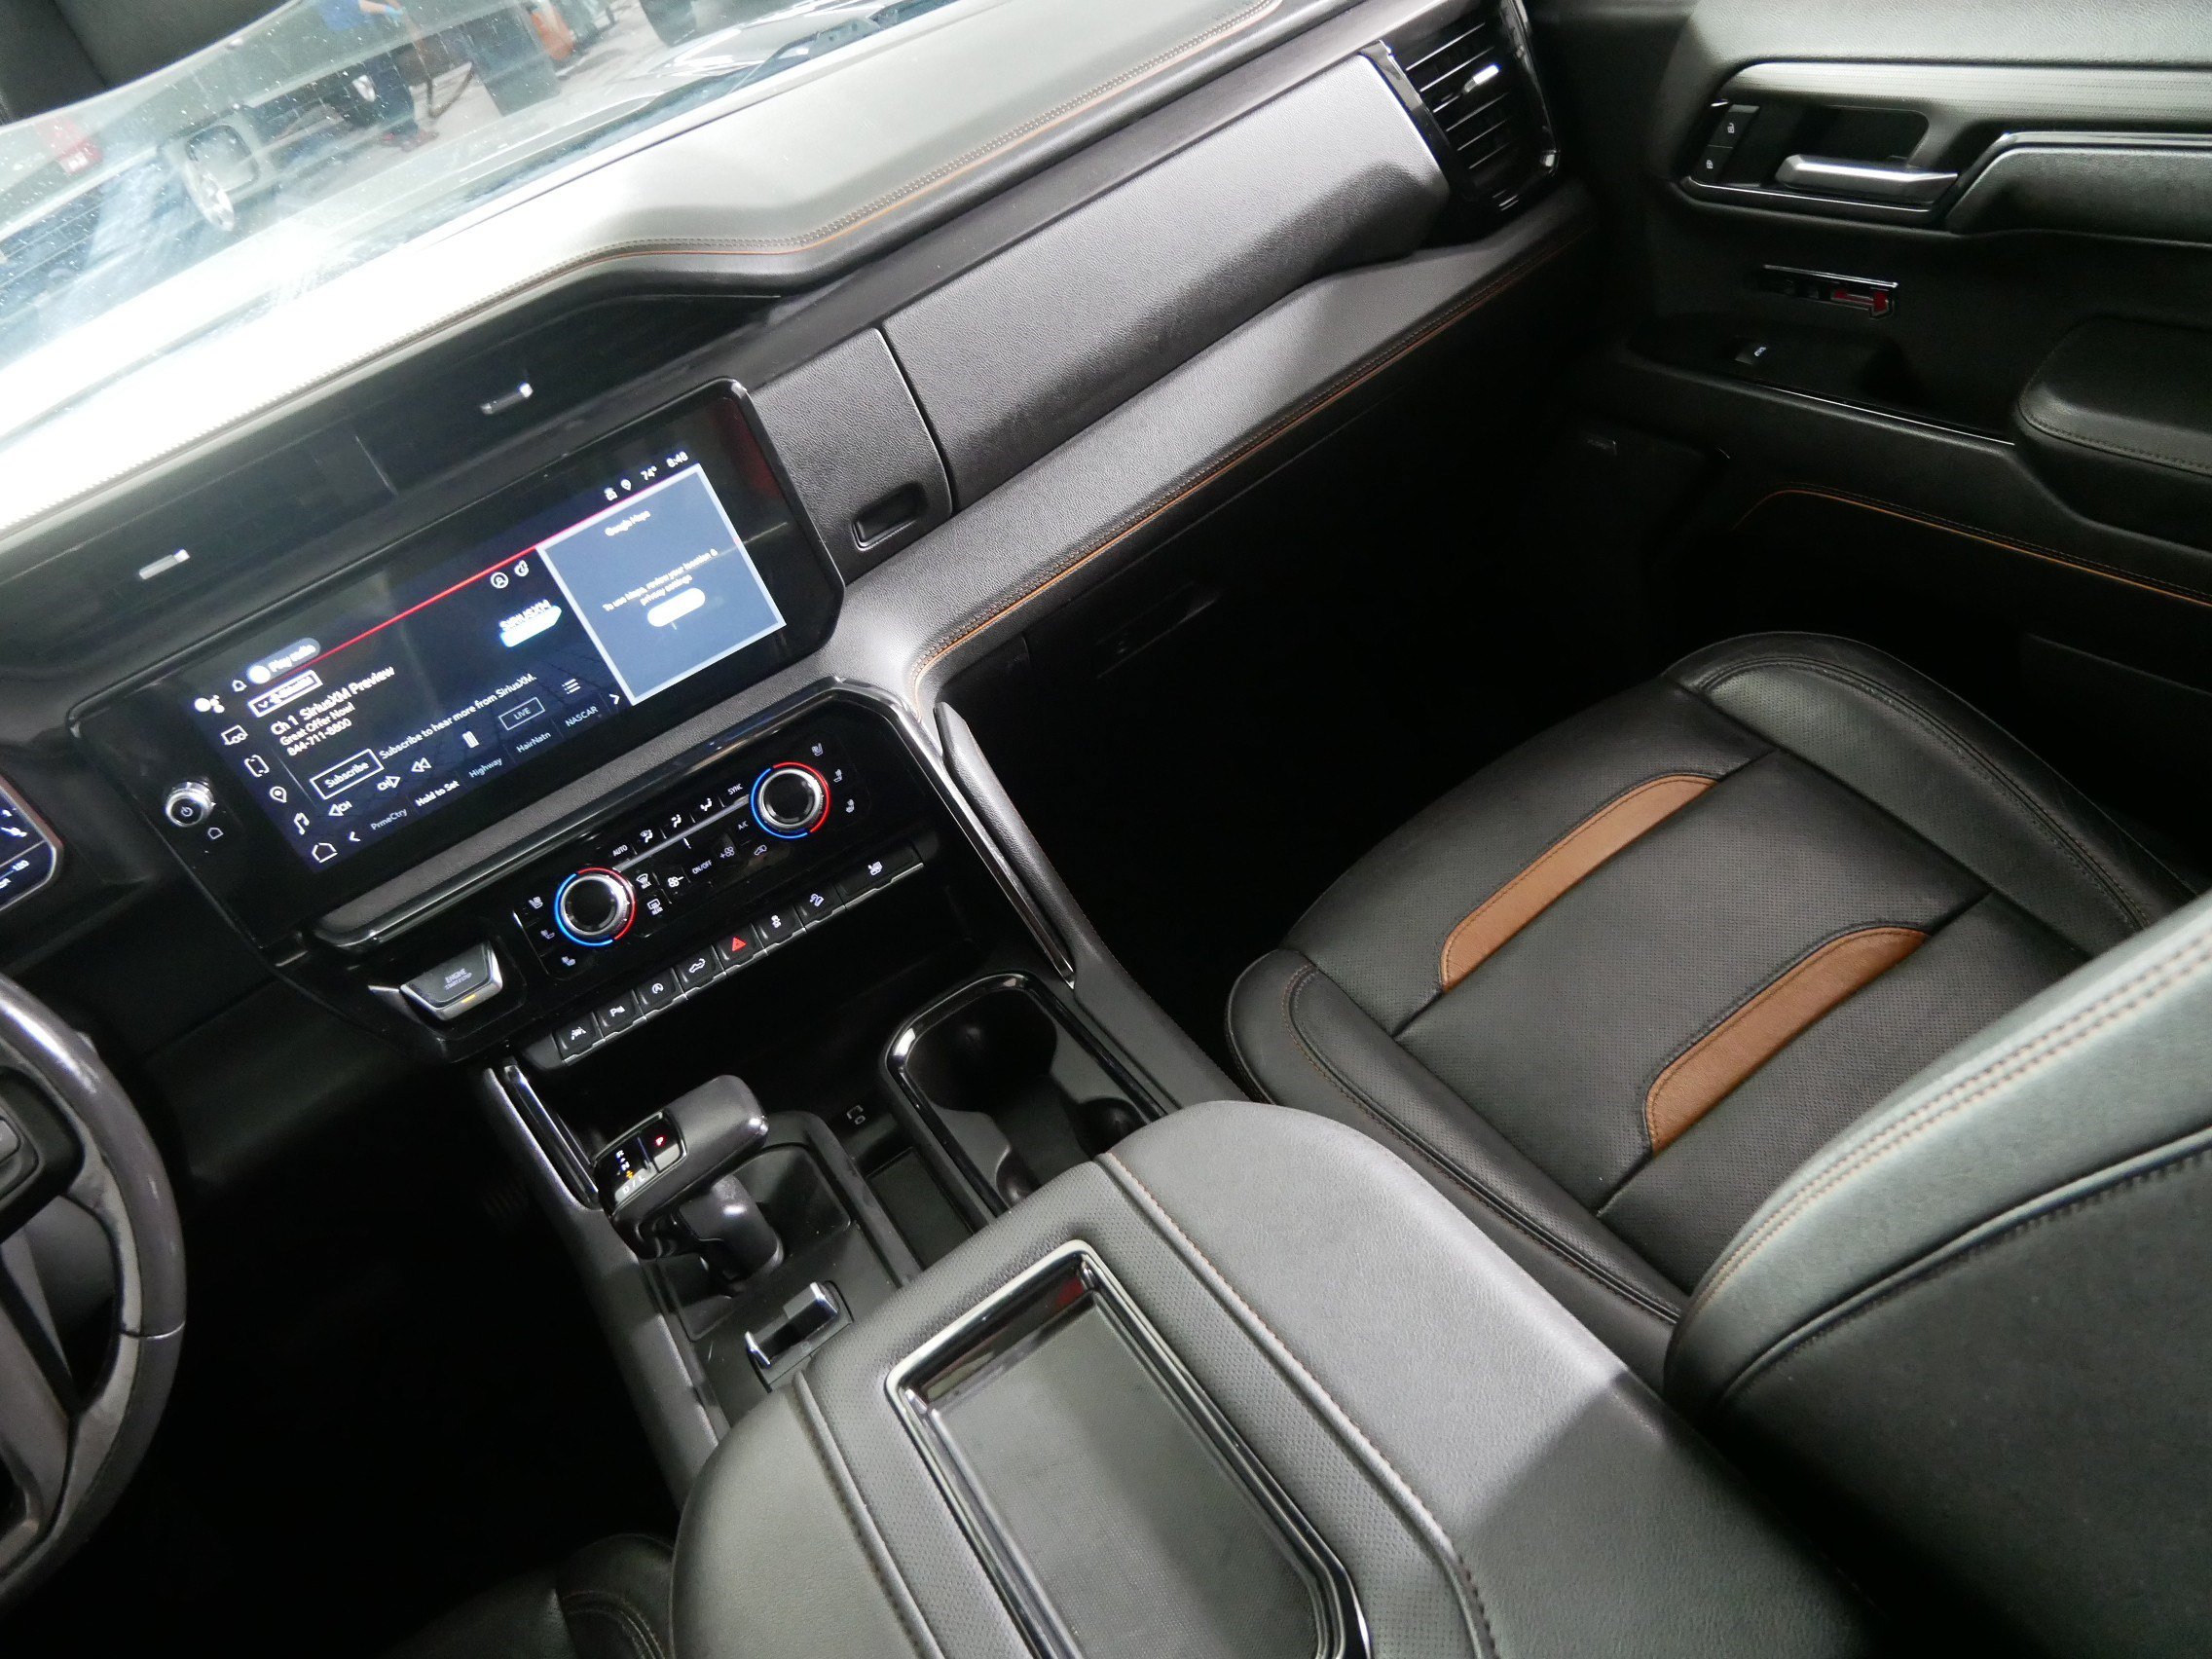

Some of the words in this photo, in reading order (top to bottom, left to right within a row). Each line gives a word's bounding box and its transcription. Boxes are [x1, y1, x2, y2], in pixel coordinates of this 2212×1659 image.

[270, 720, 291, 736] Ch
[287, 715, 299, 725] 1
[299, 686, 351, 721] SiriusXM
[348, 666, 395, 695] Preview
[513, 707, 532, 720] LIVE
[565, 706, 599, 727] NASCAR
[279, 728, 308, 746] Great
[305, 715, 333, 732] Offer
[379, 733, 424, 759] Subscribe
[421, 728, 434, 738] to
[430, 718, 453, 732] hear
[452, 706, 477, 721] more
[474, 694, 498, 710] from
[516, 731, 552, 754] HairNatn
[324, 761, 370, 789] Subscribe
[468, 757, 502, 778] Highway
[415, 792, 437, 807] Hold
[434, 786, 446, 797] to
[444, 780, 460, 792] Set
[727, 783, 744, 795] SYNC
[370, 808, 408, 830] PrmeCtry
[612, 844, 628, 857] AUTO
[691, 859, 713, 874] ON/OFF
